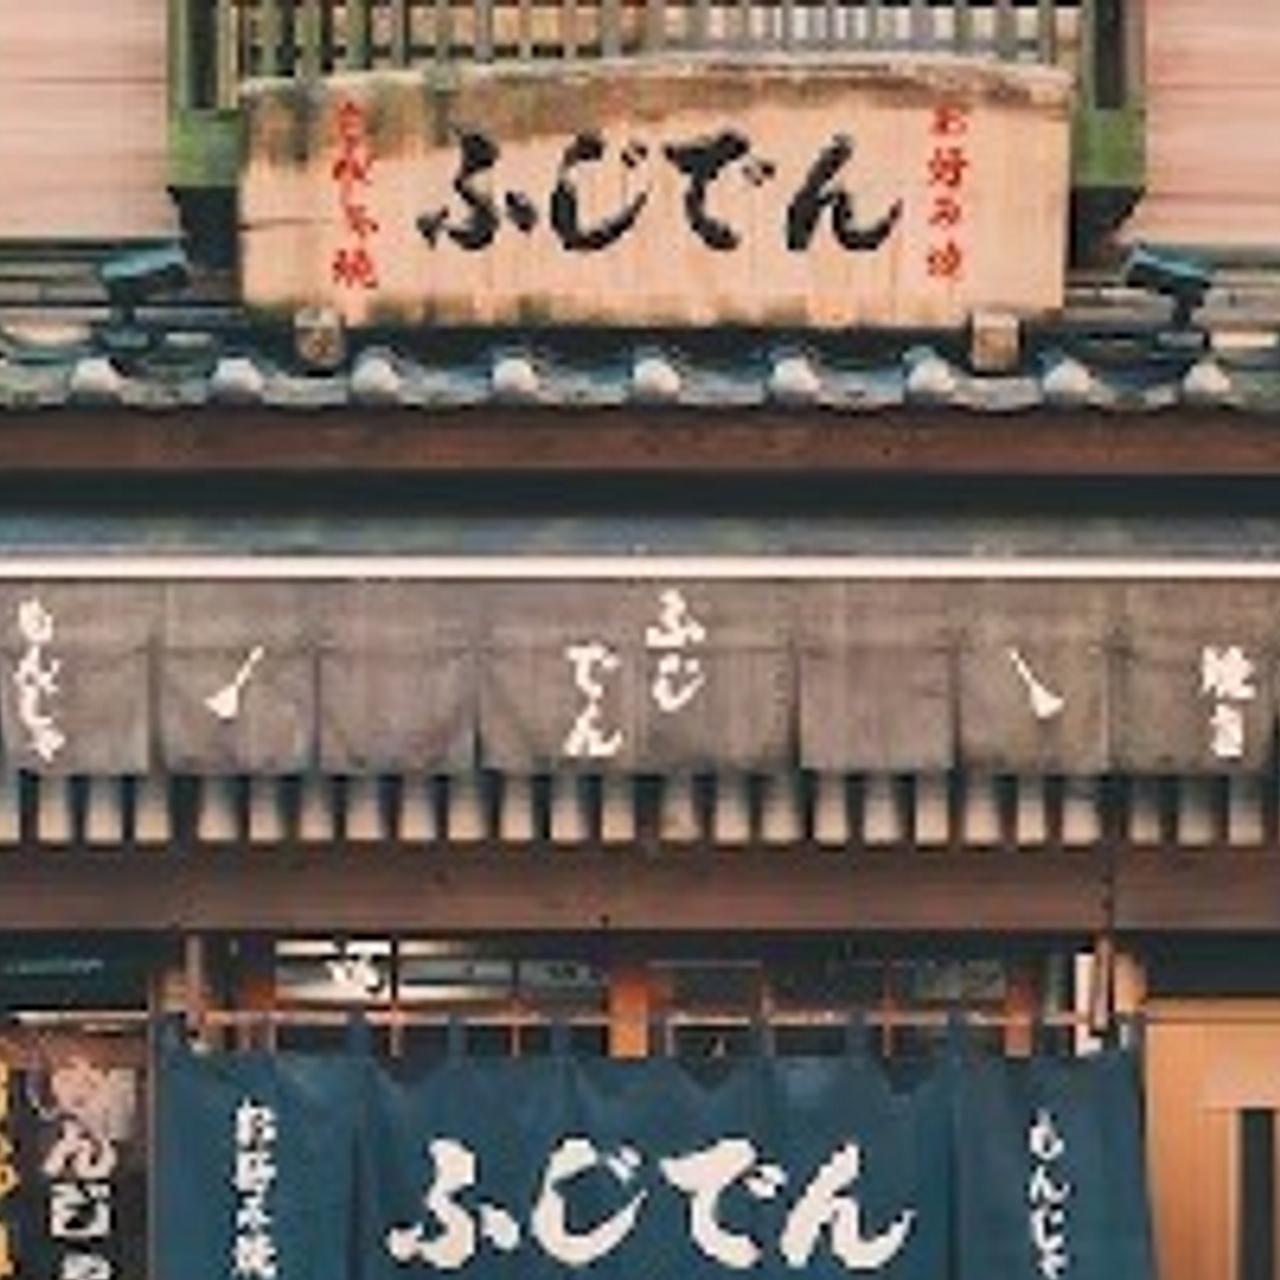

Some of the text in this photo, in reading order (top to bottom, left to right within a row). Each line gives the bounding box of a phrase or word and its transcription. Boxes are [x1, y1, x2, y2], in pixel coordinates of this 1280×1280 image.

[416, 128, 903, 253] ふじでん
[925, 102, 972, 283] お好み焼
[563, 643, 623, 758] でん
[645, 589, 706, 712] ふじ
[388, 1136, 917, 1271] ふじでん
